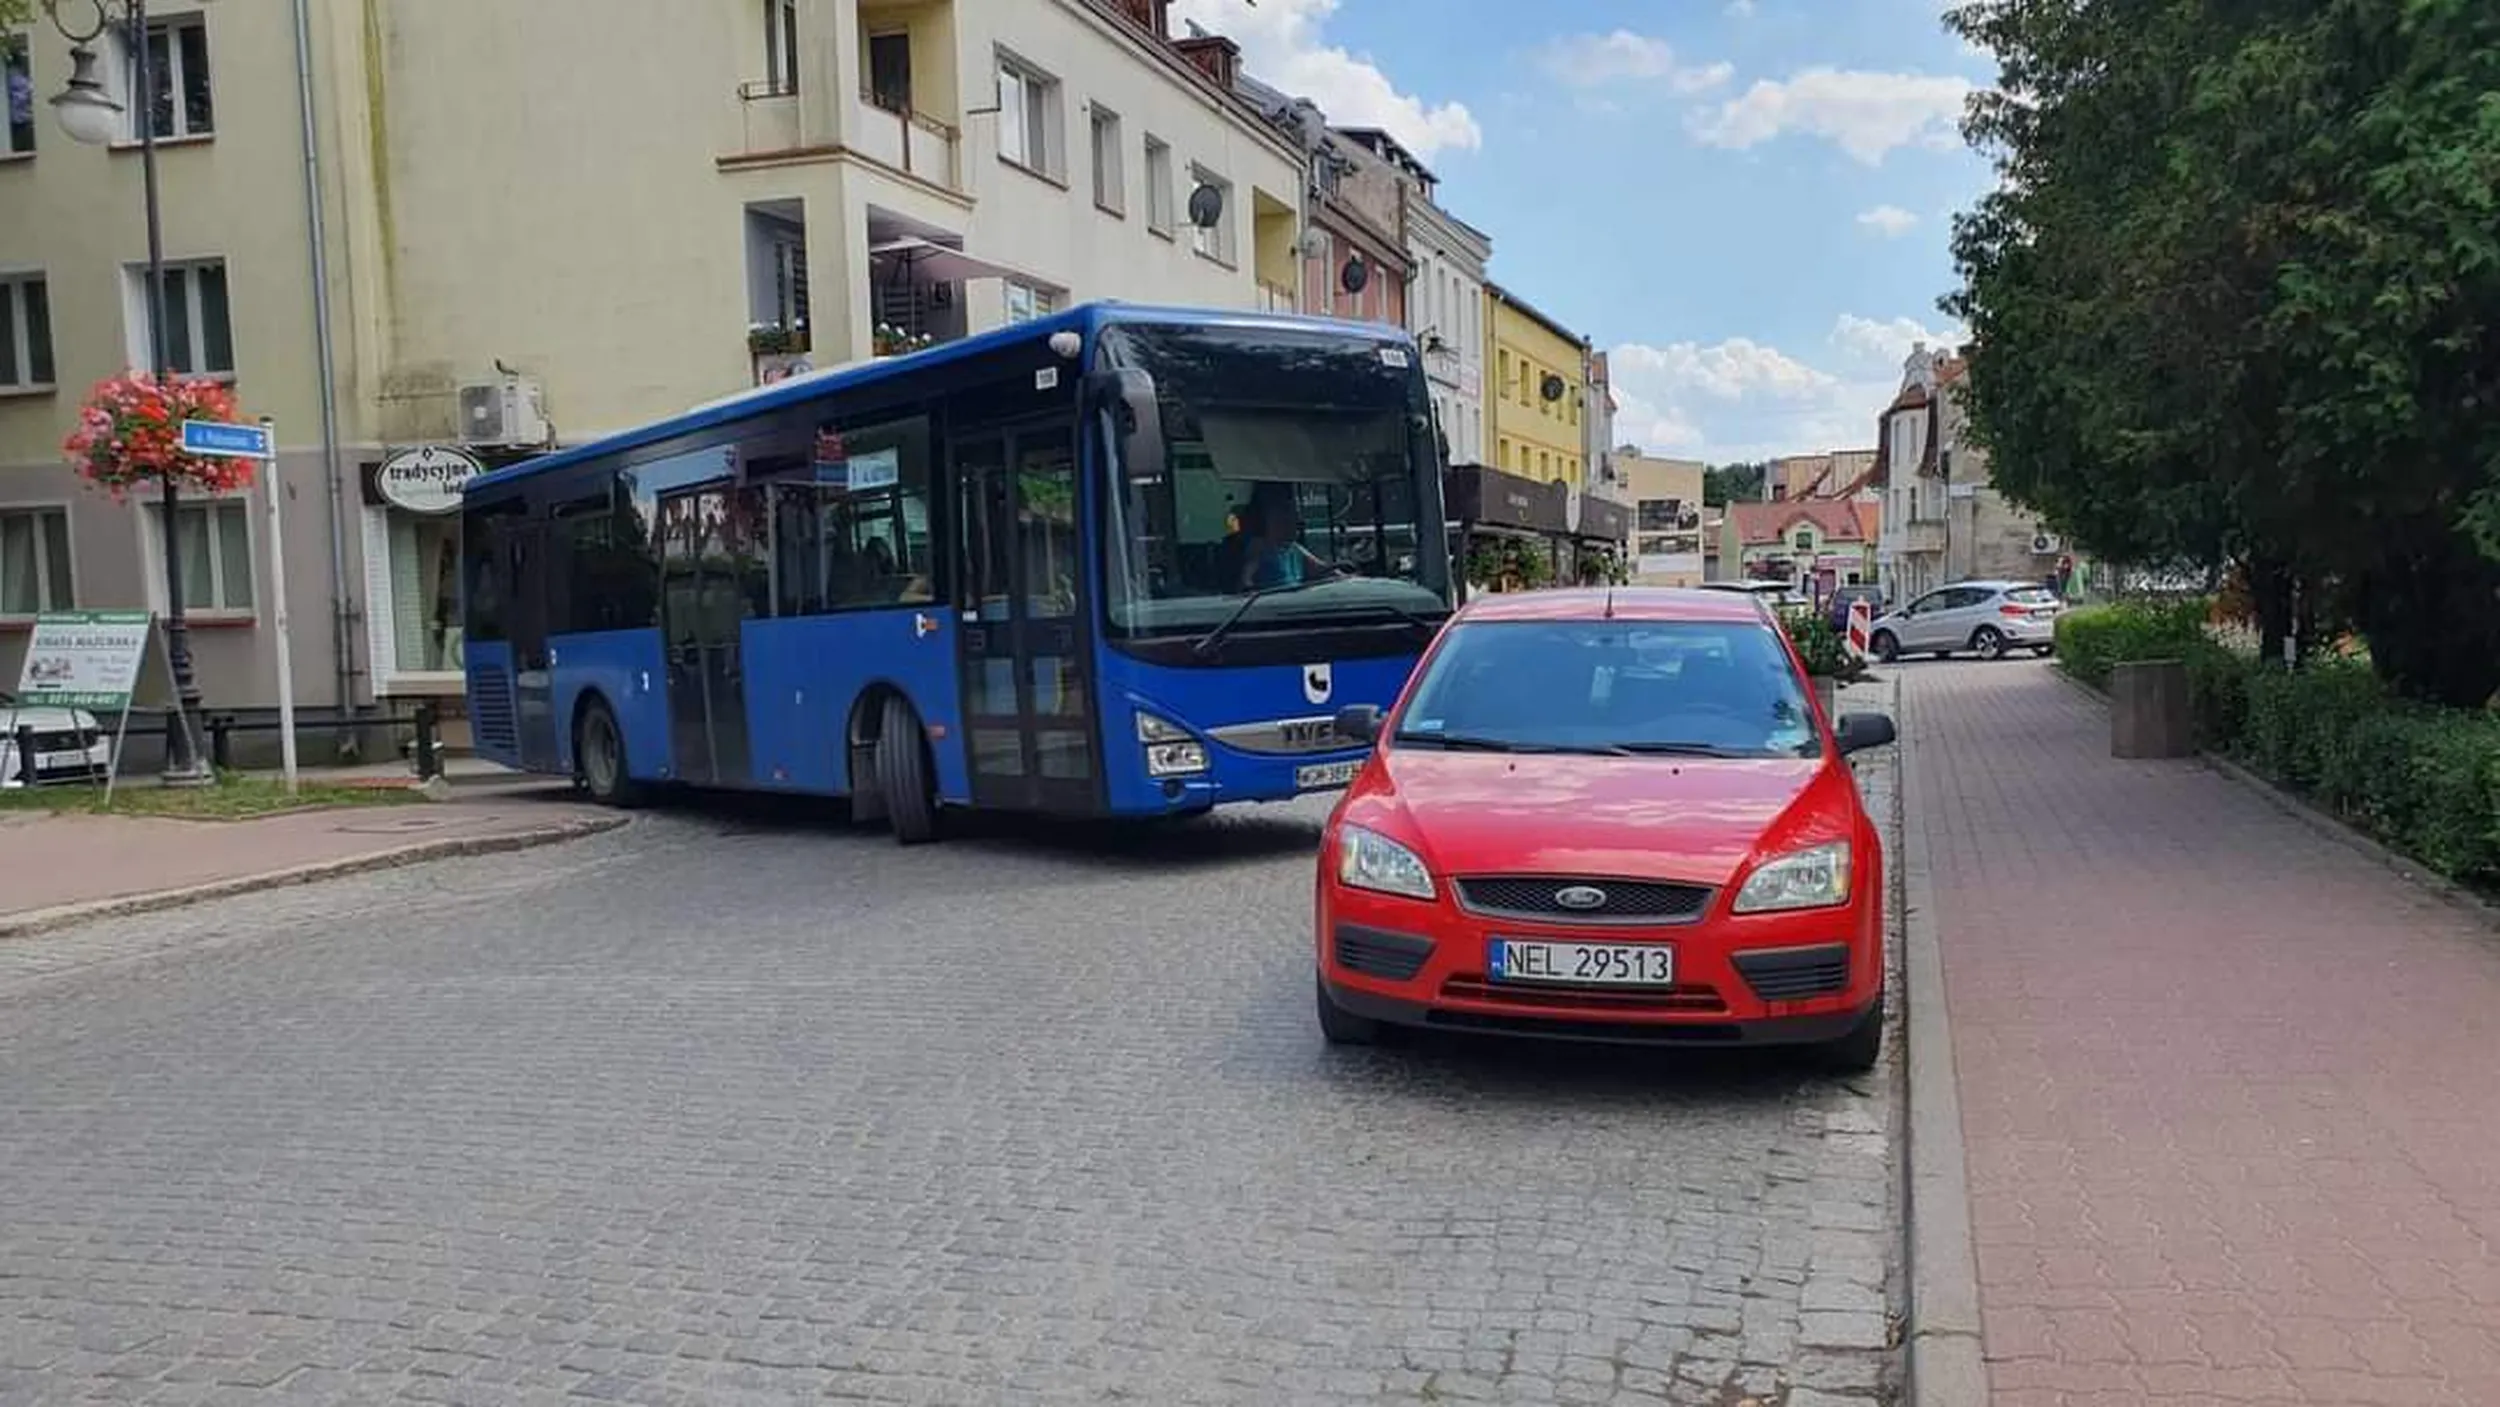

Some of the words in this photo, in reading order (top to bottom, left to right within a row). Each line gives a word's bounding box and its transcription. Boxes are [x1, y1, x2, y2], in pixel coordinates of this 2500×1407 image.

[389, 462, 468, 482] tradycyjne
[1283, 721, 1334, 744] IVE
[1506, 944, 1562, 976] NEL
[1574, 947, 1668, 980] 29513
